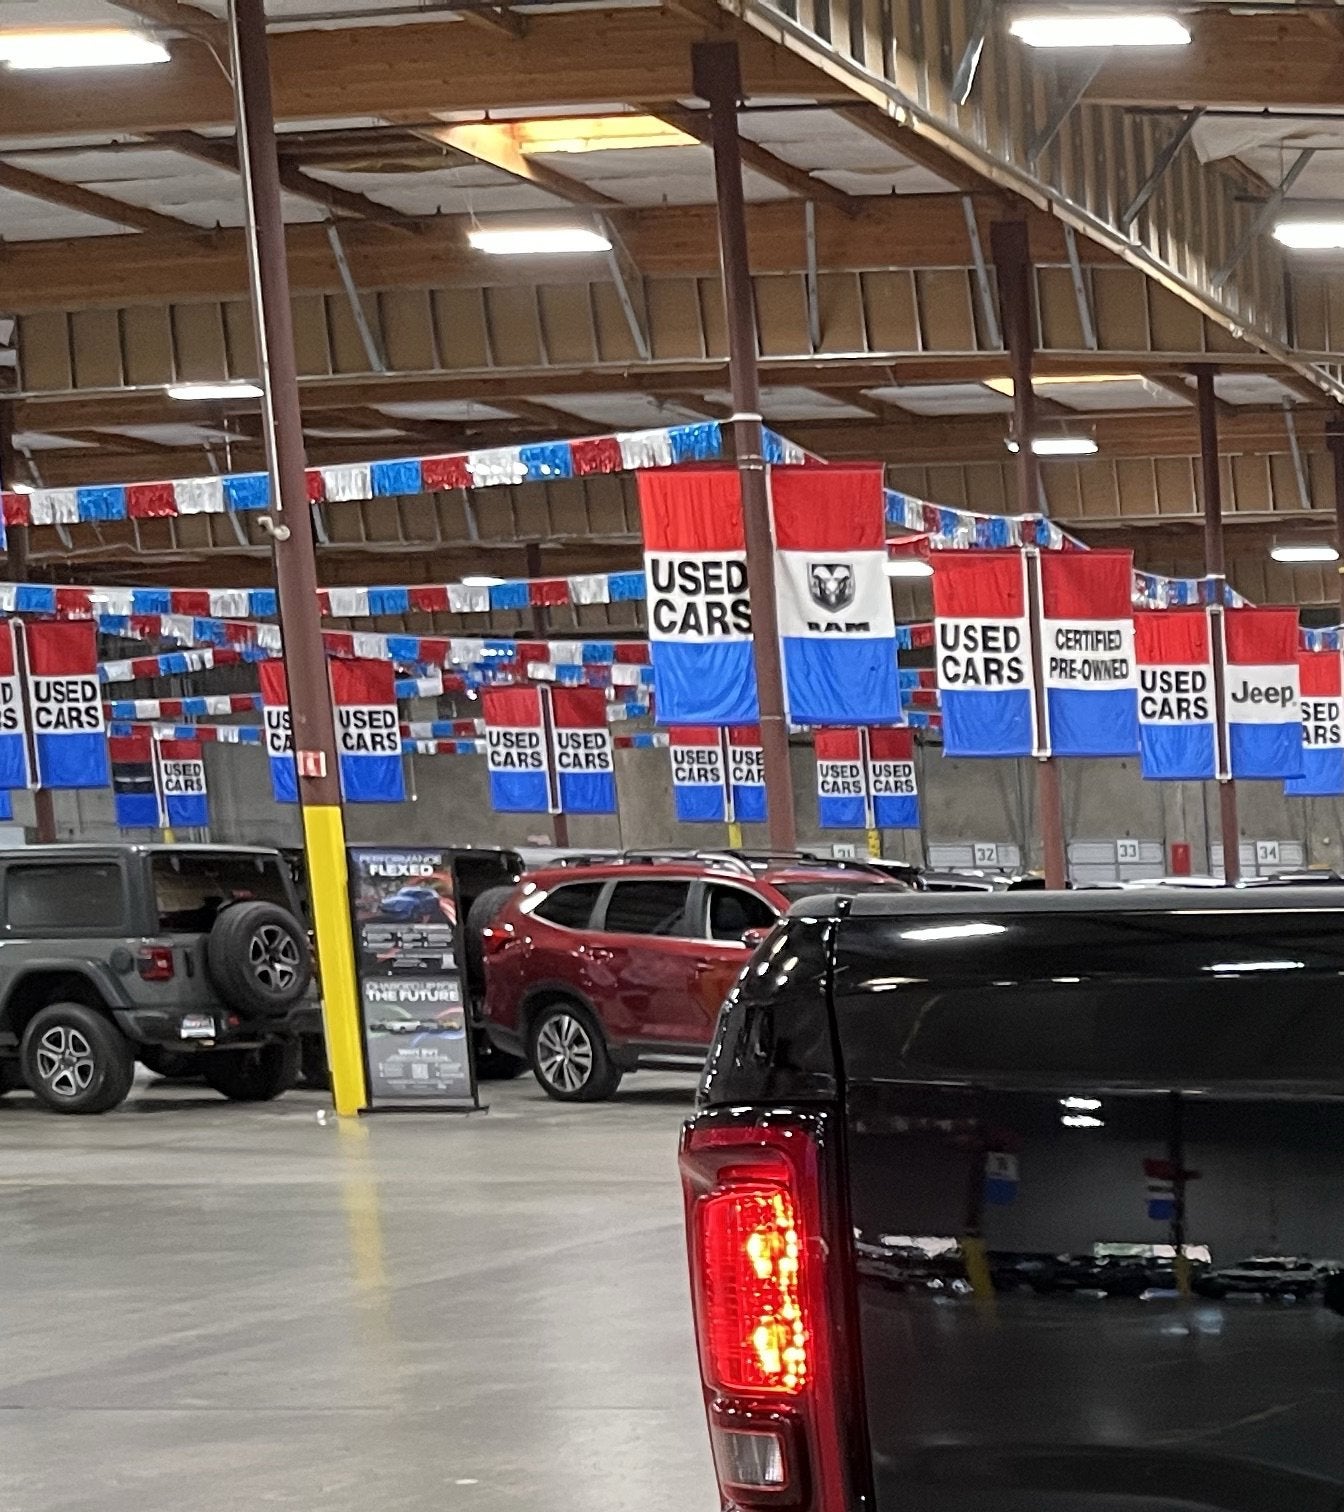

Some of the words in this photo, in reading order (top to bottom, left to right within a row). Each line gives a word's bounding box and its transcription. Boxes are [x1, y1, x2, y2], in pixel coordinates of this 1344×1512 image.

[651, 559, 748, 595] USED
[653, 599, 751, 635] CARS
[807, 622, 871, 632] RAM
[941, 624, 1020, 653] USED
[1055, 629, 1121, 650] CERTIFIED
[942, 655, 1025, 685] CARS
[1049, 657, 1129, 681] PRE-OWNED
[1140, 670, 1207, 693] USED
[34, 681, 97, 703] USED
[1141, 696, 1209, 720] CARS
[1301, 702, 1339, 721] SED
[35, 706, 99, 729] CARS
[339, 710, 396, 729] USED
[342, 732, 397, 751] CARS
[488, 731, 540, 748] USED
[557, 732, 606, 750] USED
[1302, 724, 1341, 744] ARS
[490, 751, 543, 768] CARS
[558, 752, 609, 769] CARS
[673, 750, 718, 765] USED
[733, 750, 764, 766] USE
[164, 763, 201, 777] USED
[674, 767, 721, 783] CARS
[820, 764, 860, 779] USED
[872, 763, 912, 778] USED
[165, 778, 203, 792] CARS
[820, 780, 862, 794] CARS
[872, 780, 914, 794] CARS
[977, 848, 995, 861] 32
[1119, 844, 1137, 857] 33
[1259, 846, 1277, 859] 34
[369, 864, 434, 876] FLEXED
[367, 990, 397, 1001] THE
[399, 990, 459, 1001] FUTURE
